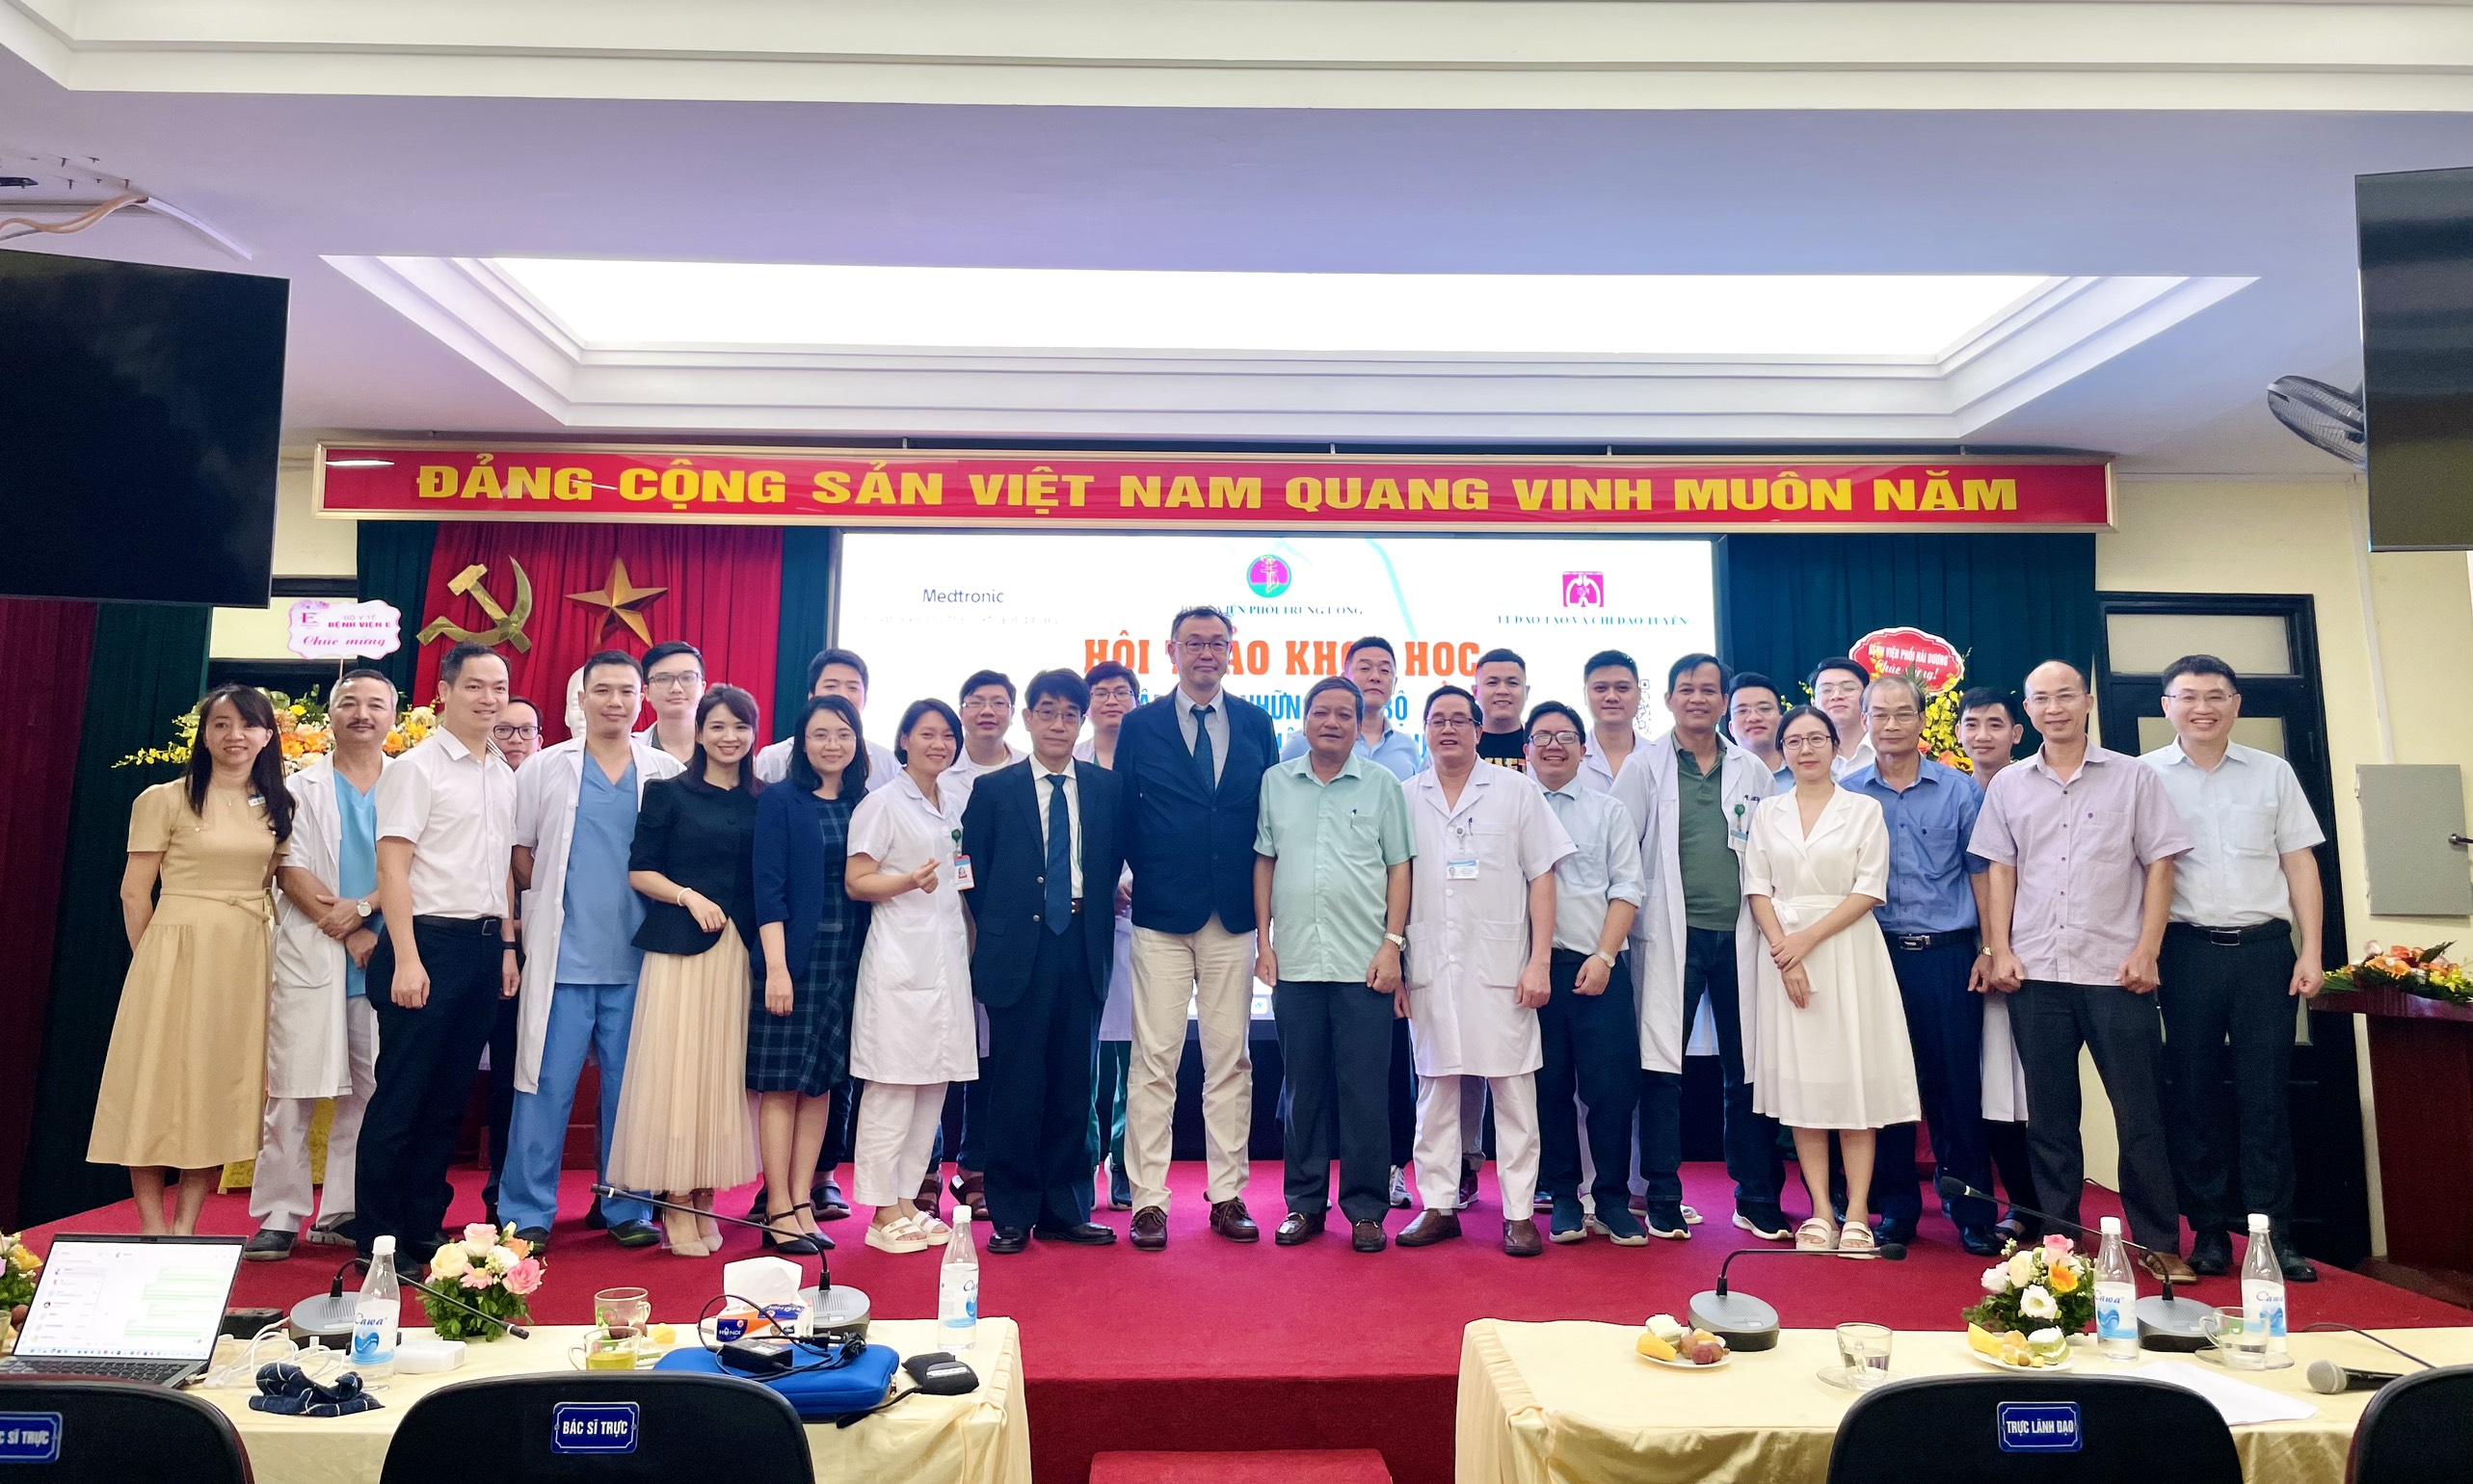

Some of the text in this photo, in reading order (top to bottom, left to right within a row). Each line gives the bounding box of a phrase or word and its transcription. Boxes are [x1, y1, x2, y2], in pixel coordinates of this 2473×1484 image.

[416, 453, 2017, 515] ĐẢNG CỘNG SẢN VIỆT NAM QUANG VINH MUÔN NĂM
[922, 588, 1004, 603] Medtronic
[1404, 641, 1480, 686] HỌC
[562, 1418, 584, 1435] BÁC
[600, 1418, 628, 1438] TRỰC
[2006, 1419, 2030, 1437] TRỰC
[2031, 1418, 2055, 1434] LÃNH
